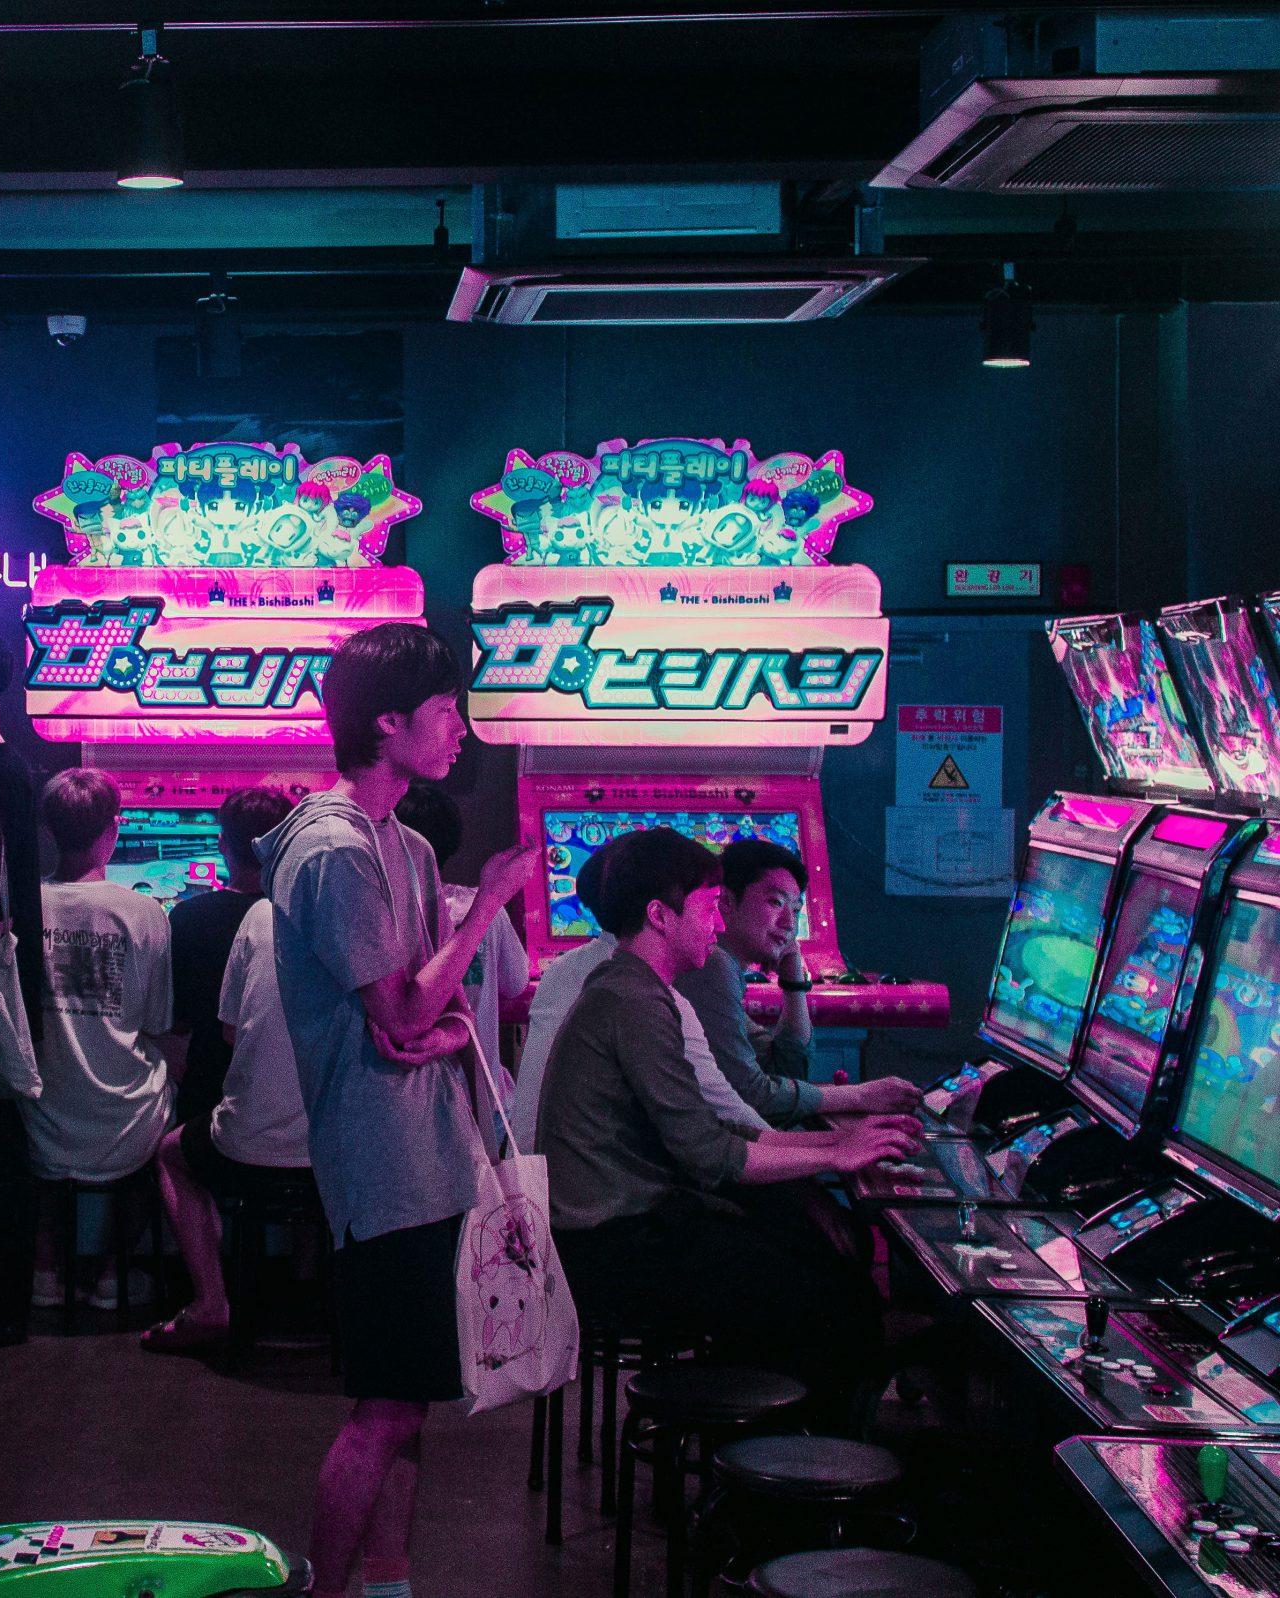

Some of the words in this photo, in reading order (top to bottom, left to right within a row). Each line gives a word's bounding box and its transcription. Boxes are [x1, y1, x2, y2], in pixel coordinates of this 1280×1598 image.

[159, 453, 298, 487] 파티플레이
[602, 450, 746, 488] 파티플레이
[228, 597, 247, 607] THE
[258, 595, 314, 607] BishiBashi
[680, 595, 700, 604] THE
[711, 594, 770, 604] BishiBashi
